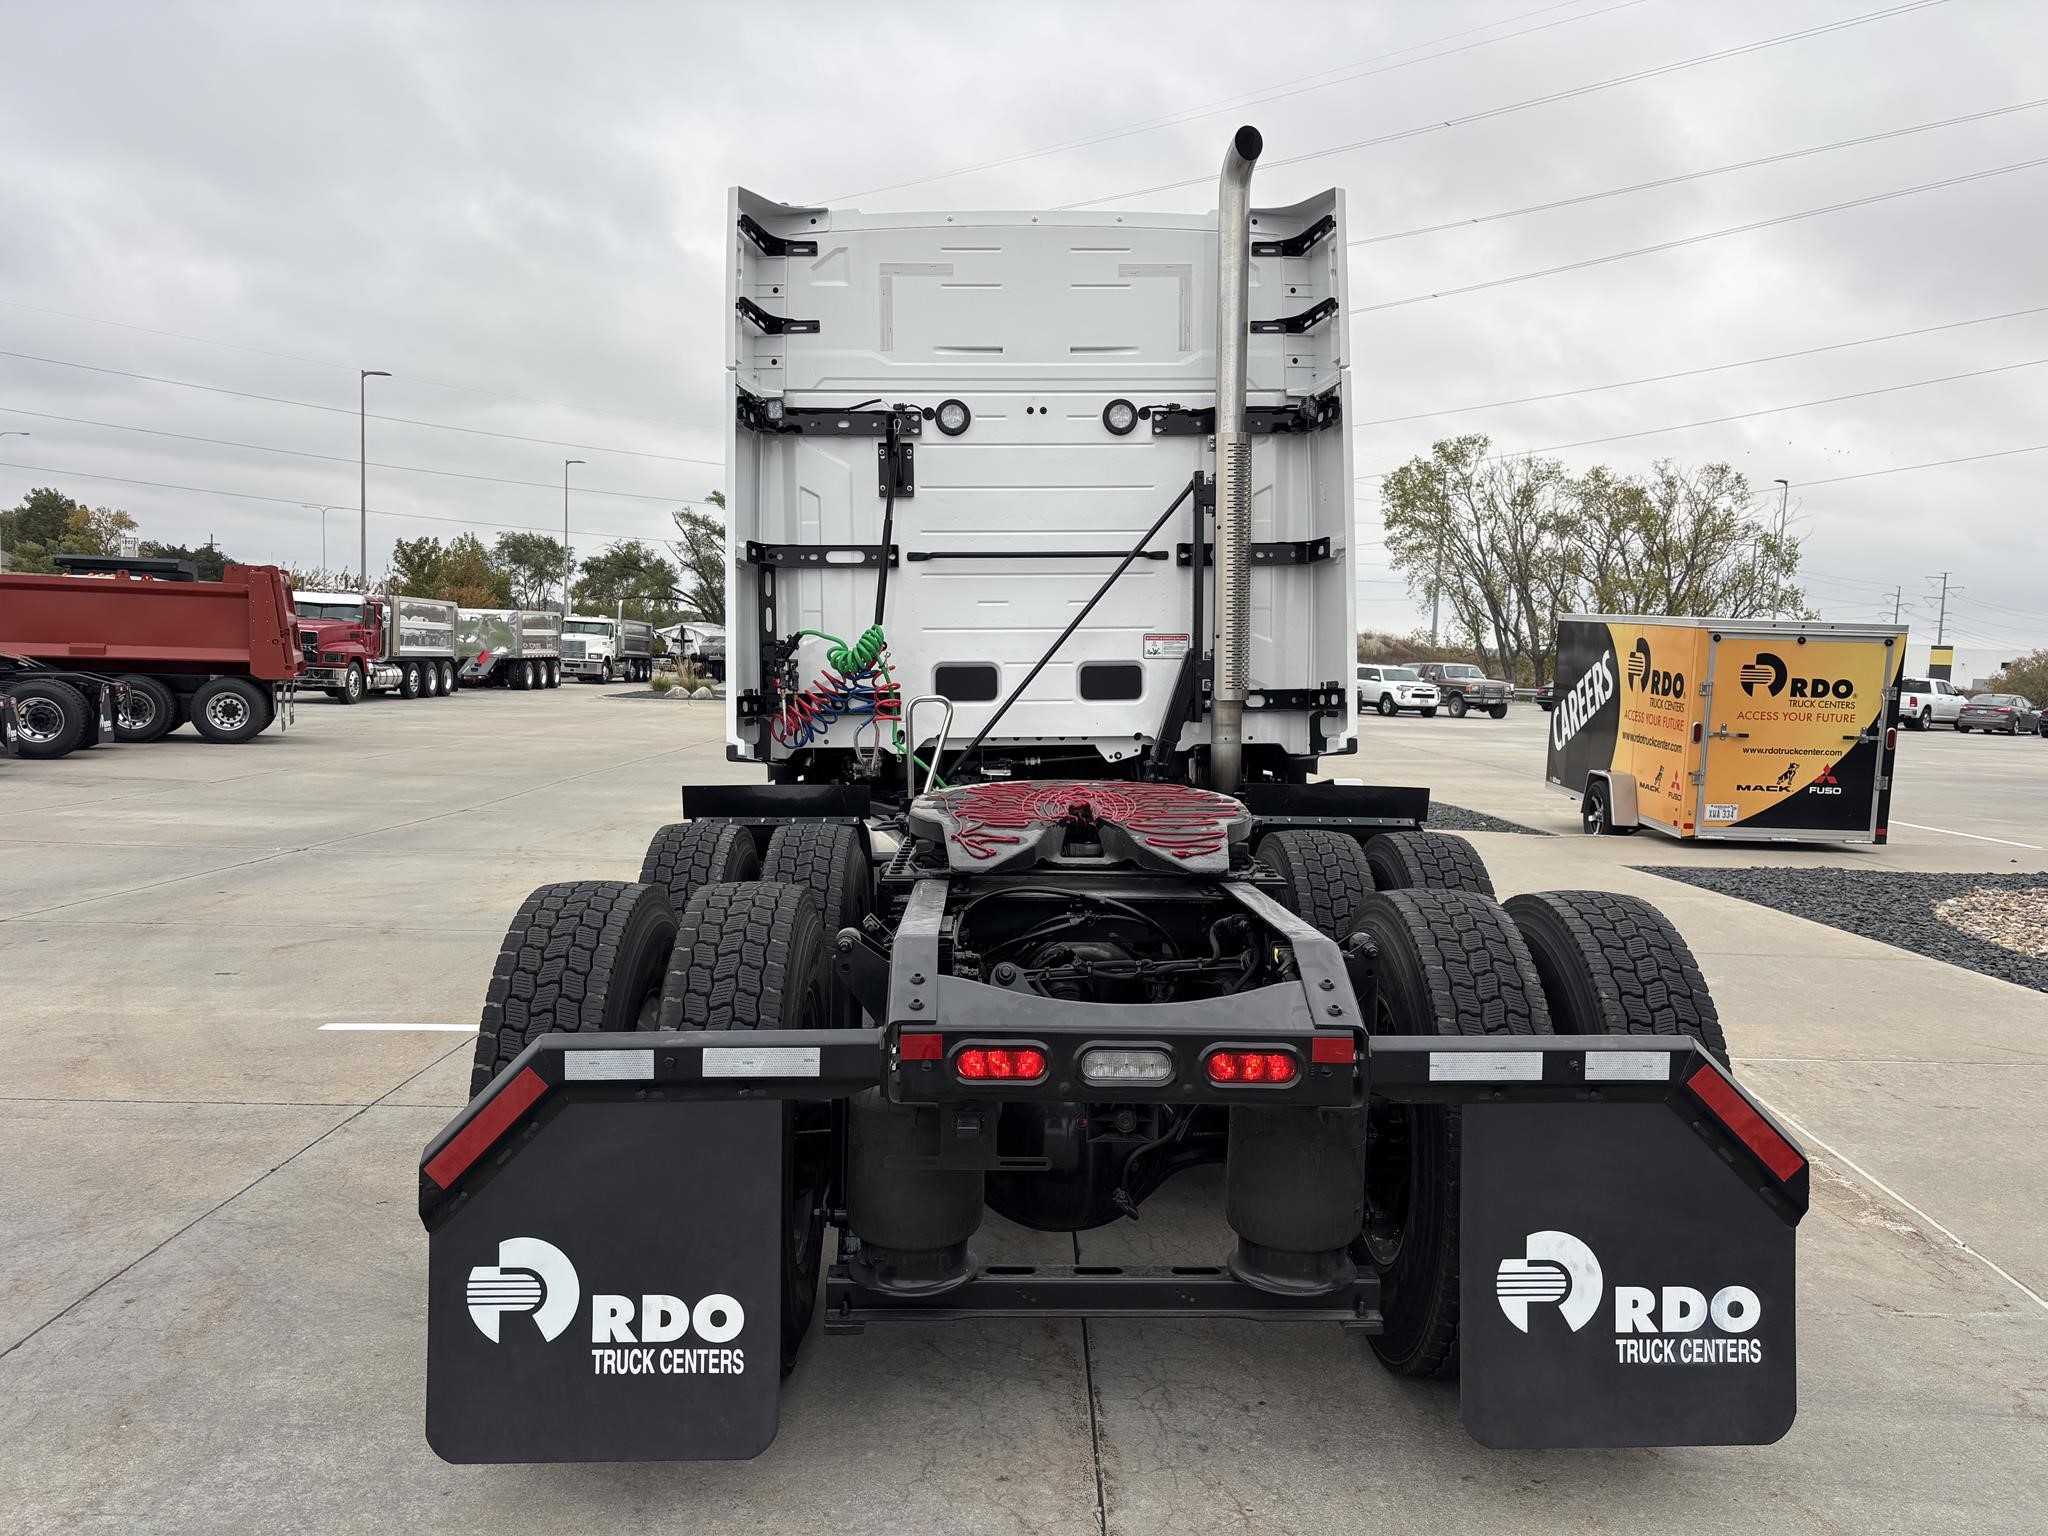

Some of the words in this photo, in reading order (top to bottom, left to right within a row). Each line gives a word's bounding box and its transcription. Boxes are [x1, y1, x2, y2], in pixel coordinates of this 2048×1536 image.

[1651, 669, 1685, 699] RDO
[1789, 677, 1854, 699] RDO
[1553, 650, 1614, 751] CAREERS
[1649, 697, 1663, 709] TRUCK
[1664, 700, 1685, 713] CENTERS
[1789, 699, 1815, 708] TRUCK
[1818, 700, 1856, 709] CENTERS
[1624, 709, 1645, 723] ACCESS
[1646, 712, 1661, 726] YOUR
[1663, 716, 1685, 732] FUTURE
[1737, 711, 1779, 721] ACCESS
[1783, 712, 1812, 722] YOUR
[1816, 713, 1856, 723] FUTURE
[1622, 731, 1683, 754] www.rdotruckcenter.com
[1742, 747, 1843, 757] www.rdotruckcenter.com
[1639, 781, 1659, 793] MACK
[1668, 791, 1682, 801] FUSO
[1736, 784, 1791, 793] MACK
[1809, 786, 1842, 795] FUSO
[1722, 809, 1734, 819] 334
[592, 1293, 745, 1344] RDO
[1615, 1285, 1761, 1334] RDO
[1615, 1338, 1676, 1364] TRUCK
[1680, 1338, 1762, 1364] CENTERS
[592, 1348, 655, 1375] TRUCK
[659, 1348, 745, 1375] CENTERS
